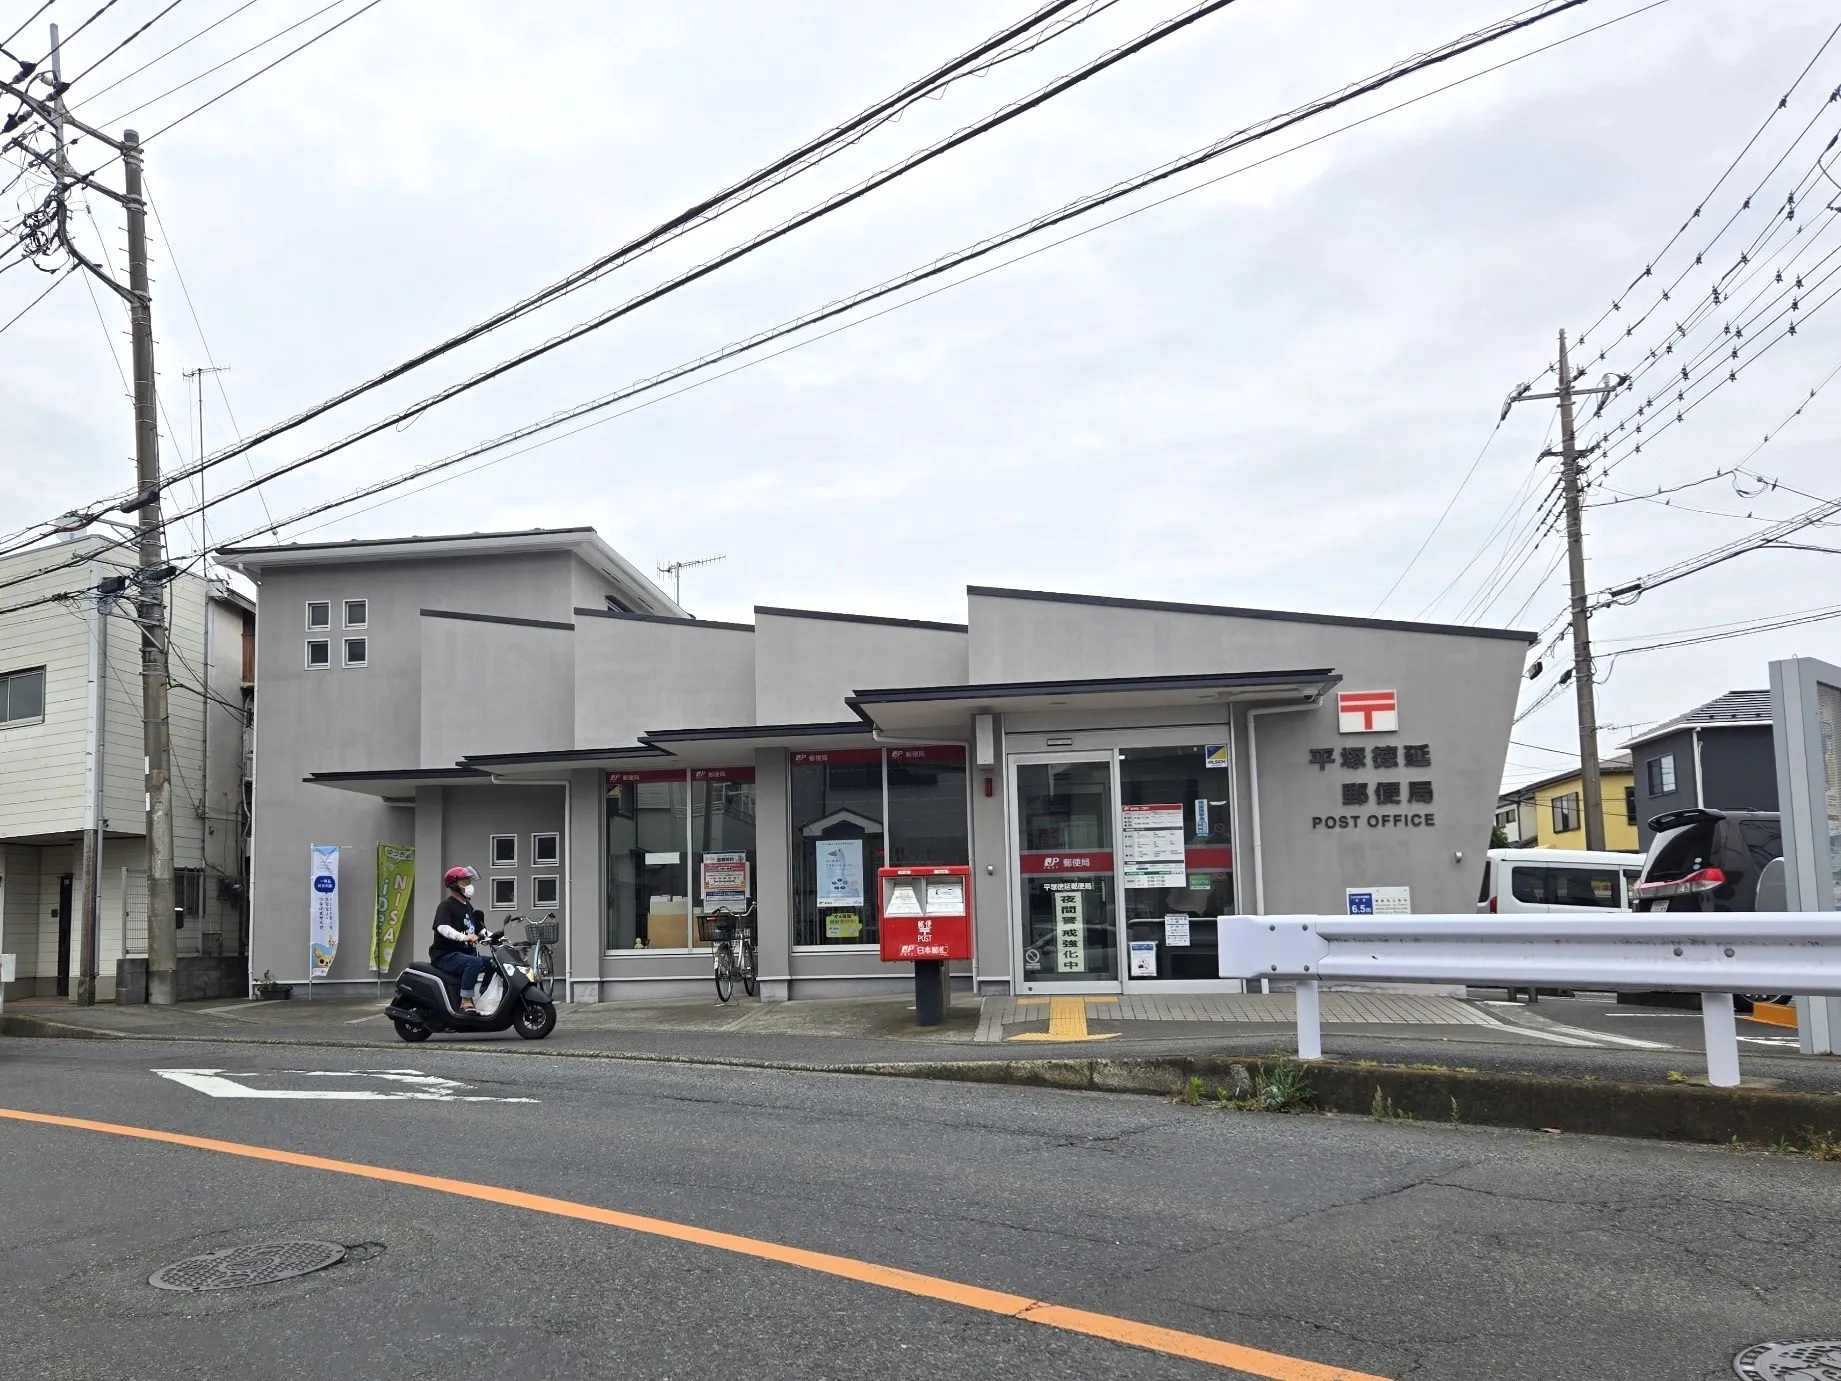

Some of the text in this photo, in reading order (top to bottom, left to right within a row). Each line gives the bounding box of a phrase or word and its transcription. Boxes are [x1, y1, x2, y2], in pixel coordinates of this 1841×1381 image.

[1309, 744, 1432, 771] 平塚徳延
[1342, 780, 1433, 806] 郵便局
[1312, 813, 1436, 829] POST OFFICE
[1063, 858, 1091, 867] 郵便局
[1043, 882, 1092, 891] 平塚徳延郵便局
[383, 874, 408, 942] NISA
[1352, 905, 1371, 913] 6.5m
[917, 920, 932, 928] 郵便
[1060, 895, 1079, 970] 夜間警戒強化中
